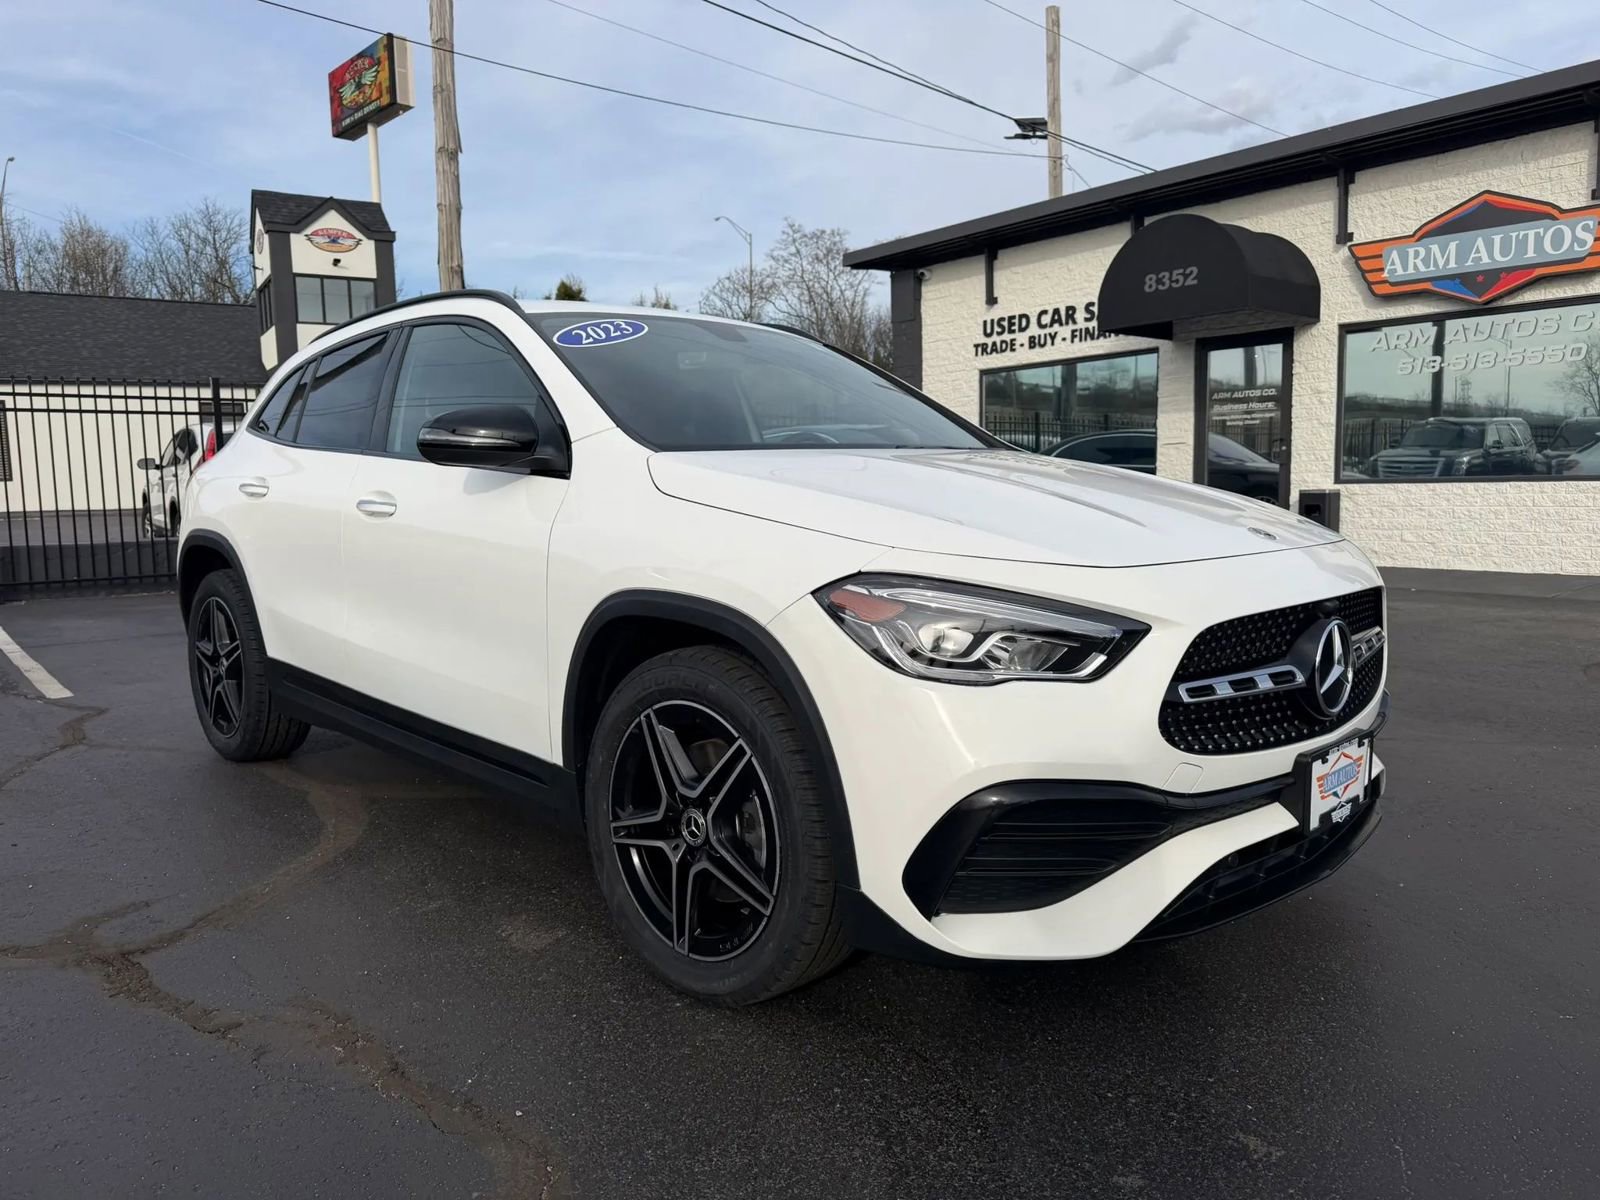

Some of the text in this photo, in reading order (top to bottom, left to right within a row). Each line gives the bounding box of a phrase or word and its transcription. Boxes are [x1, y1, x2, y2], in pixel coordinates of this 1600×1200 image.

[1382, 220, 1596, 279] ARM AUTOS
[1144, 266, 1198, 292] 8352
[572, 320, 634, 345] 2023
[983, 313, 1031, 338] USED
[1036, 305, 1077, 329] CAR
[1371, 325, 1438, 352] ARM
[1443, 314, 1562, 344] AUTOS
[974, 338, 1017, 357] TRADE
[1028, 331, 1058, 350] BUY
[1211, 392, 1231, 400] ARM
[1232, 389, 1261, 398] AUTOS
